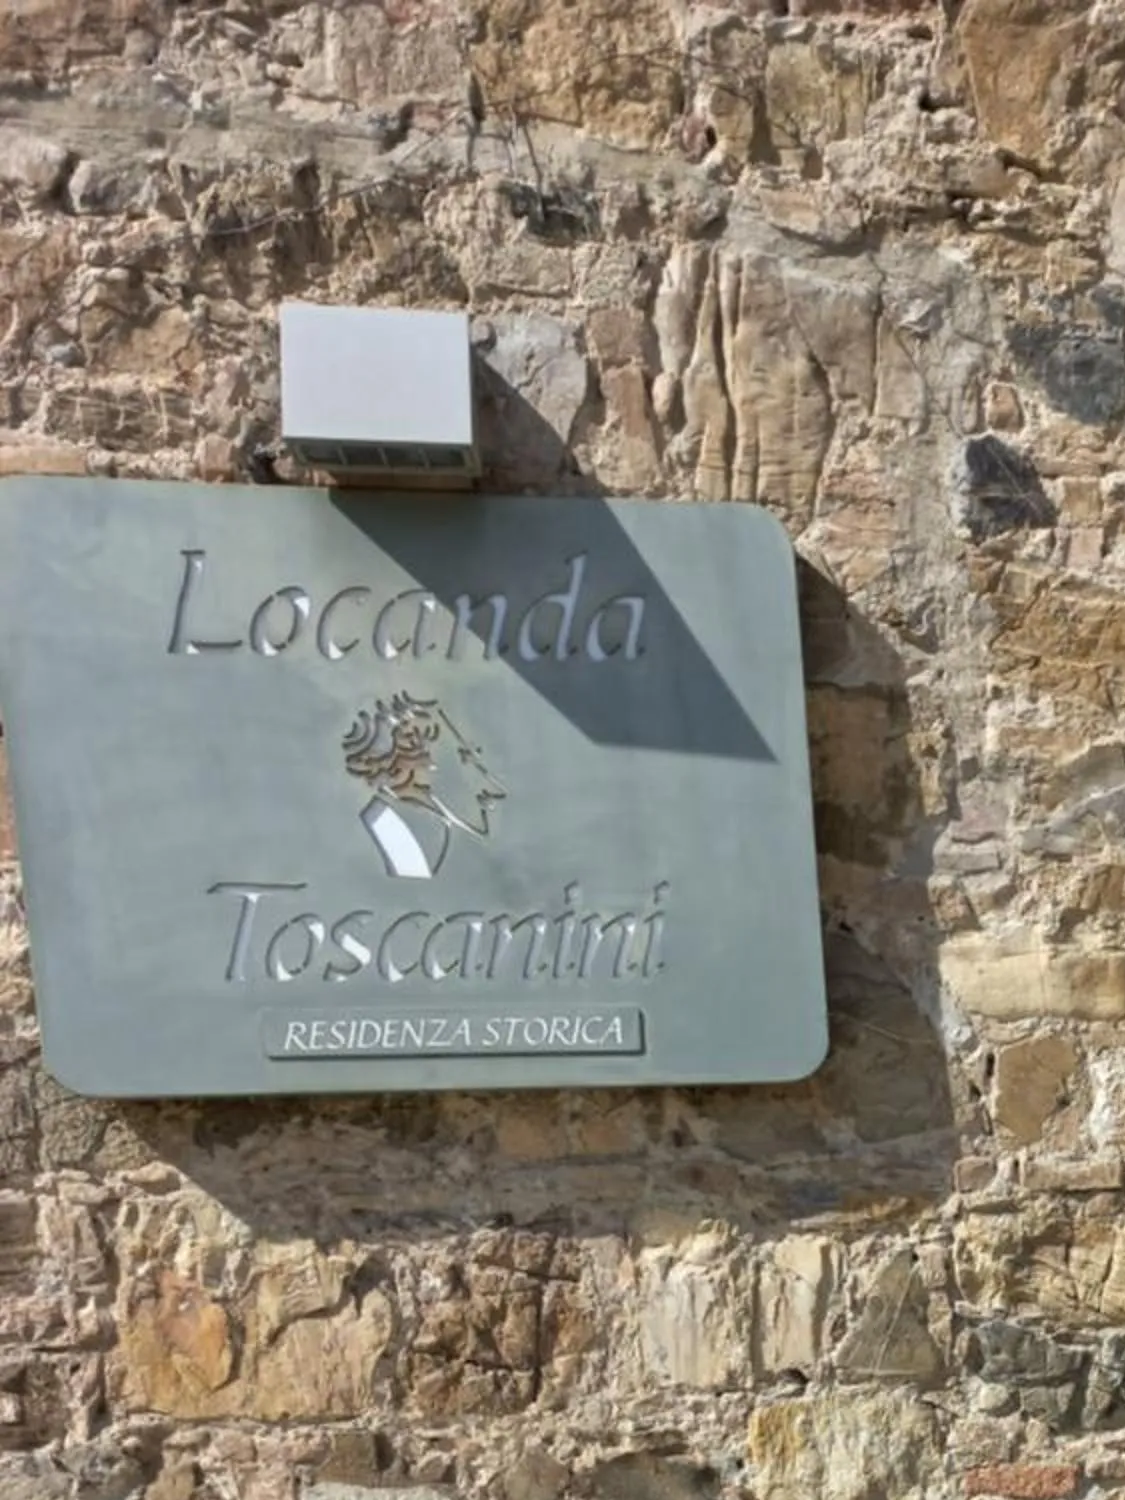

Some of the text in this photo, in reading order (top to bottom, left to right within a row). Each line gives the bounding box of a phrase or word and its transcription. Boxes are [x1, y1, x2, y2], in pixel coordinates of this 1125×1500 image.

[167, 548, 648, 662] Locanda
[206, 879, 671, 985] Toscanini
[284, 1015, 625, 1051] RESIDENZA STORICA
